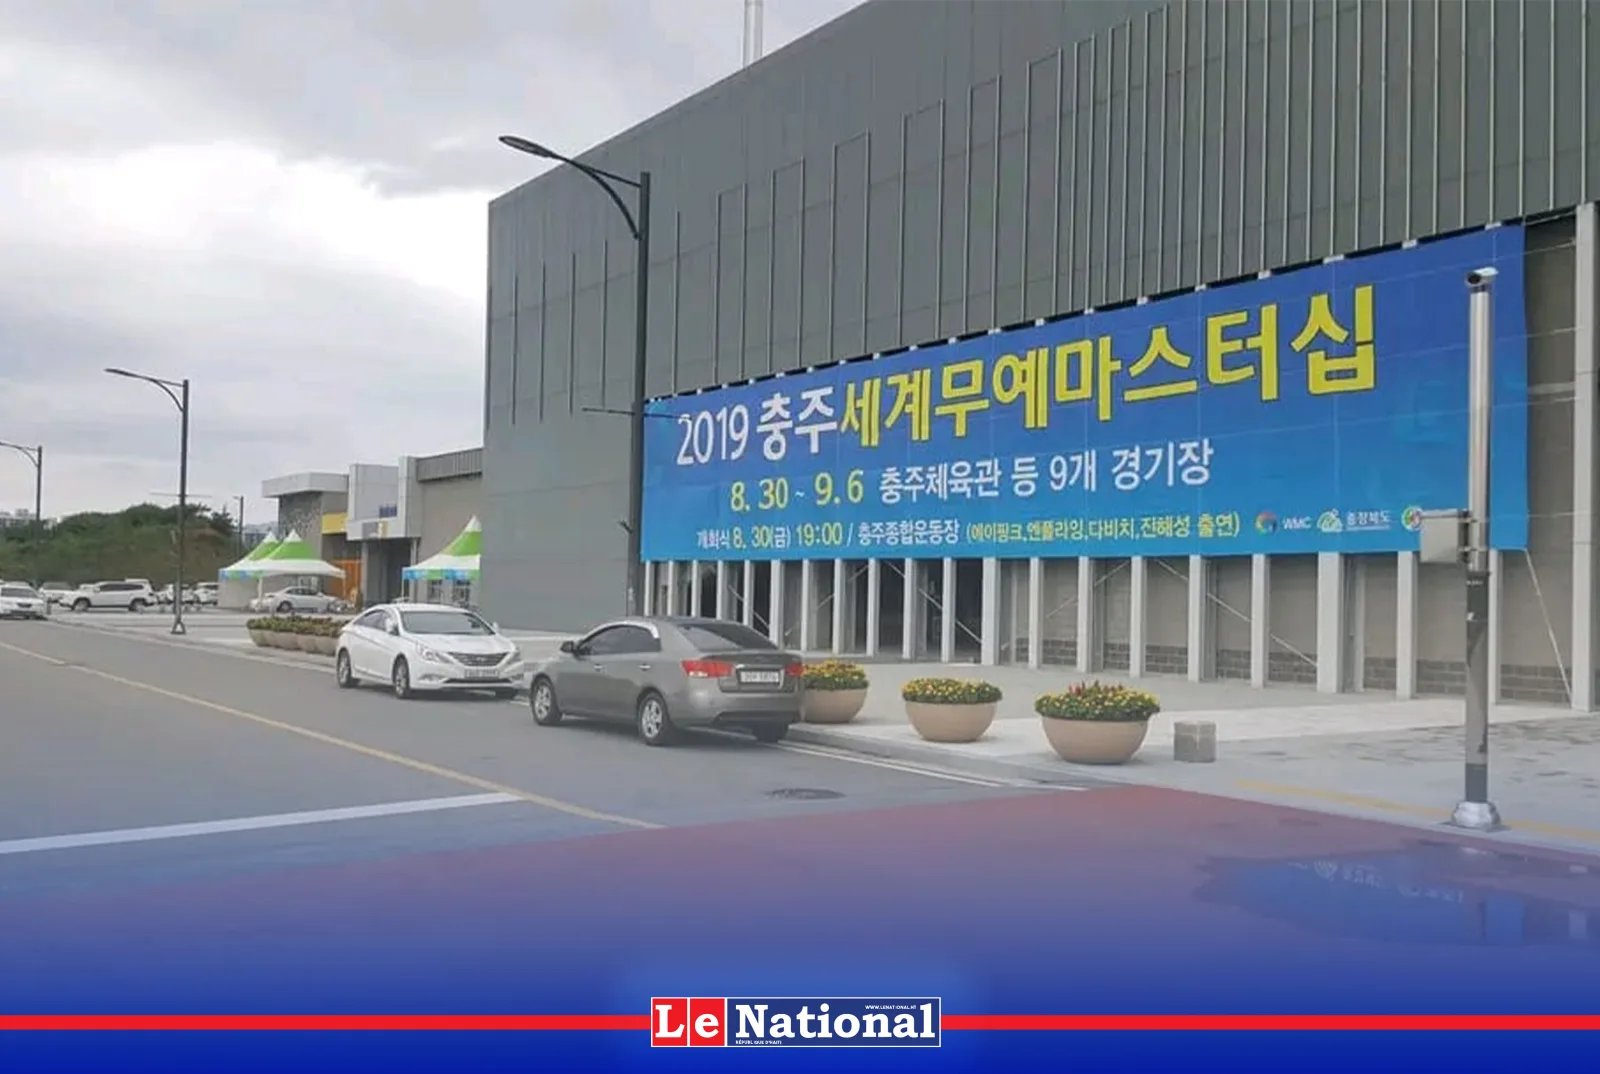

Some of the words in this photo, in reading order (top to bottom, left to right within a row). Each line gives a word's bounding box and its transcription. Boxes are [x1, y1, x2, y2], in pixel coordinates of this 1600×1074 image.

[676, 404, 750, 466] 2019
[878, 456, 1002, 504] 충주체육관
[1011, 456, 1040, 497] 등
[1049, 449, 1097, 493] 9개
[1111, 438, 1214, 491] 경기장
[796, 521, 843, 546] 19:00
[858, 518, 960, 546] 충주종합운동장
[1197, 511, 1240, 538] 출연)
[1283, 515, 1312, 530] WMC
